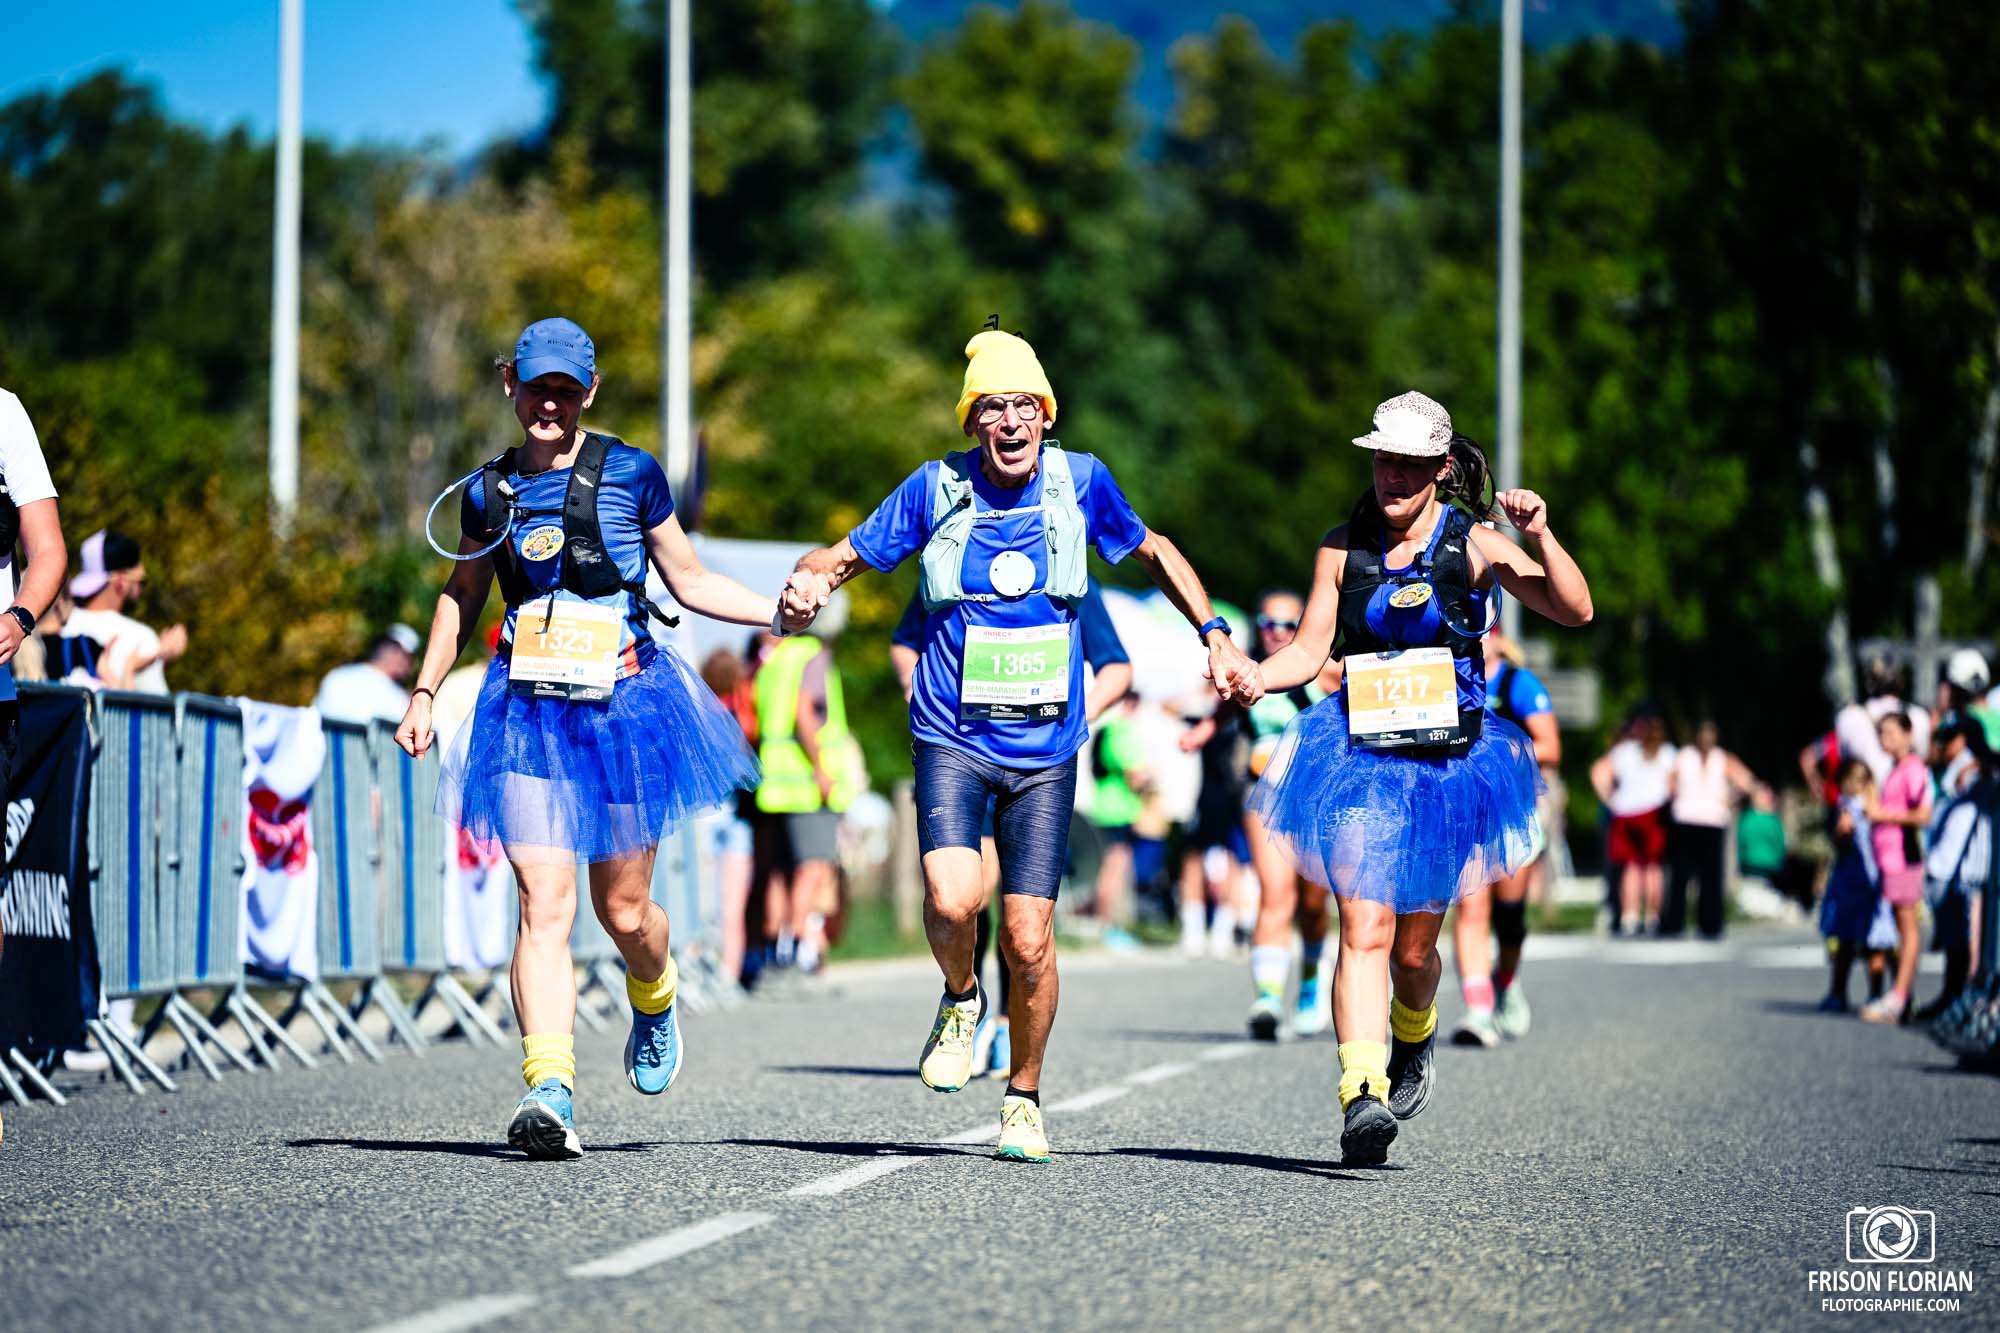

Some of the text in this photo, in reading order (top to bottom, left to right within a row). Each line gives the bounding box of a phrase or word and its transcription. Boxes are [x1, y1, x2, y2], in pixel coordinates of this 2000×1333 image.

[551, 534, 561, 543] 50
[983, 630, 1012, 638] ANNECY
[539, 626, 593, 654] 1323
[991, 651, 1047, 676] 1365
[966, 684, 1028, 695] SEMI-MARATHON
[1373, 674, 1431, 703] 1217
[1039, 705, 1059, 717] 1365
[1428, 730, 1450, 741] 1217
